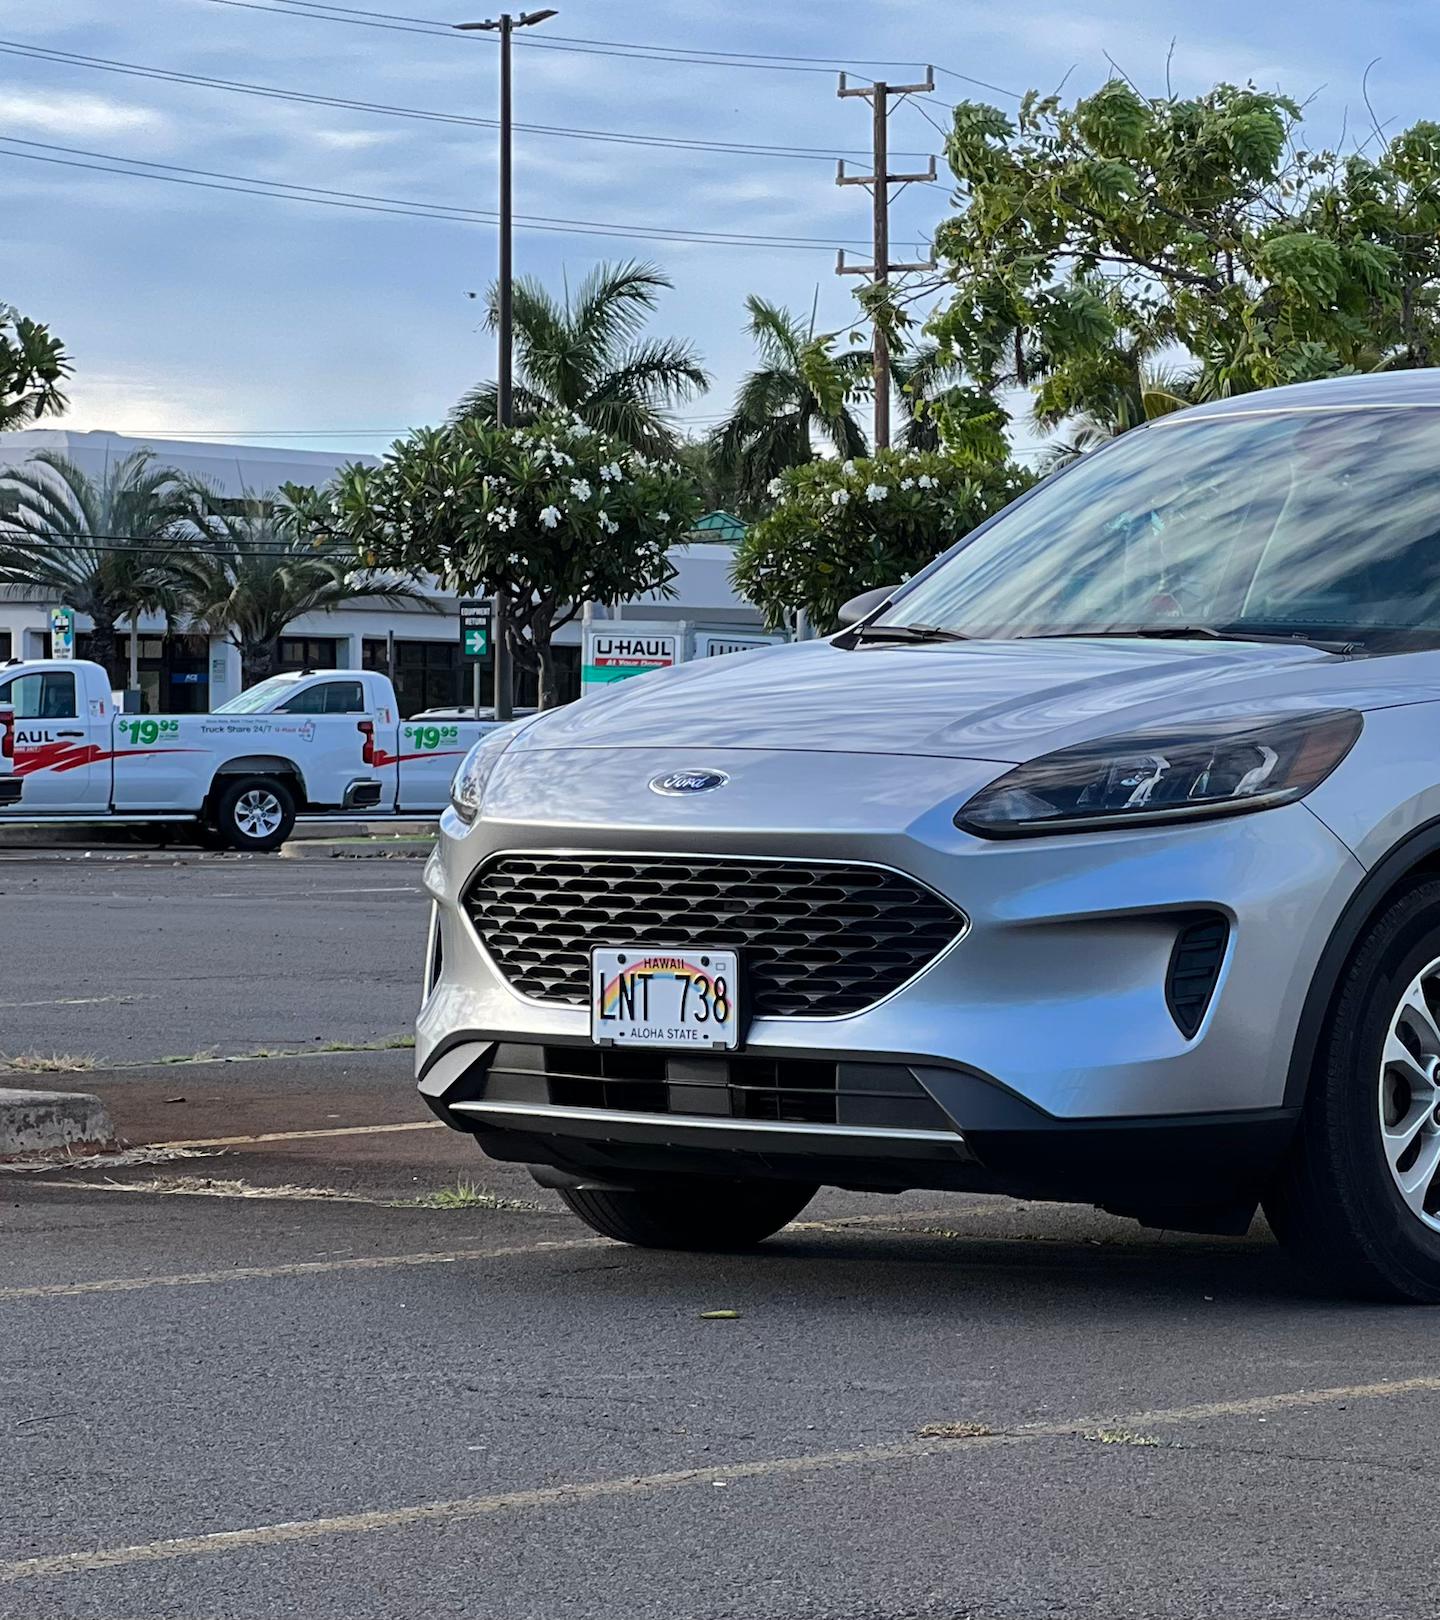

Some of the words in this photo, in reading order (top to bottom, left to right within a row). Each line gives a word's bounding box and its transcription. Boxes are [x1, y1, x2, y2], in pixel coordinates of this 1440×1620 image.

[460, 607, 490, 616] EQUIPMENT
[464, 617, 487, 625] RETURN
[597, 639, 671, 656] U-HAUL
[15, 730, 54, 743] AUL
[253, 726, 273, 735] 24/7
[663, 773, 710, 789] Ford
[643, 957, 685, 970] HAWAII
[600, 972, 654, 1021] LNT
[675, 974, 729, 1023] 738
[630, 1028, 664, 1039] ALOHA
[667, 1029, 698, 1040] STATE
